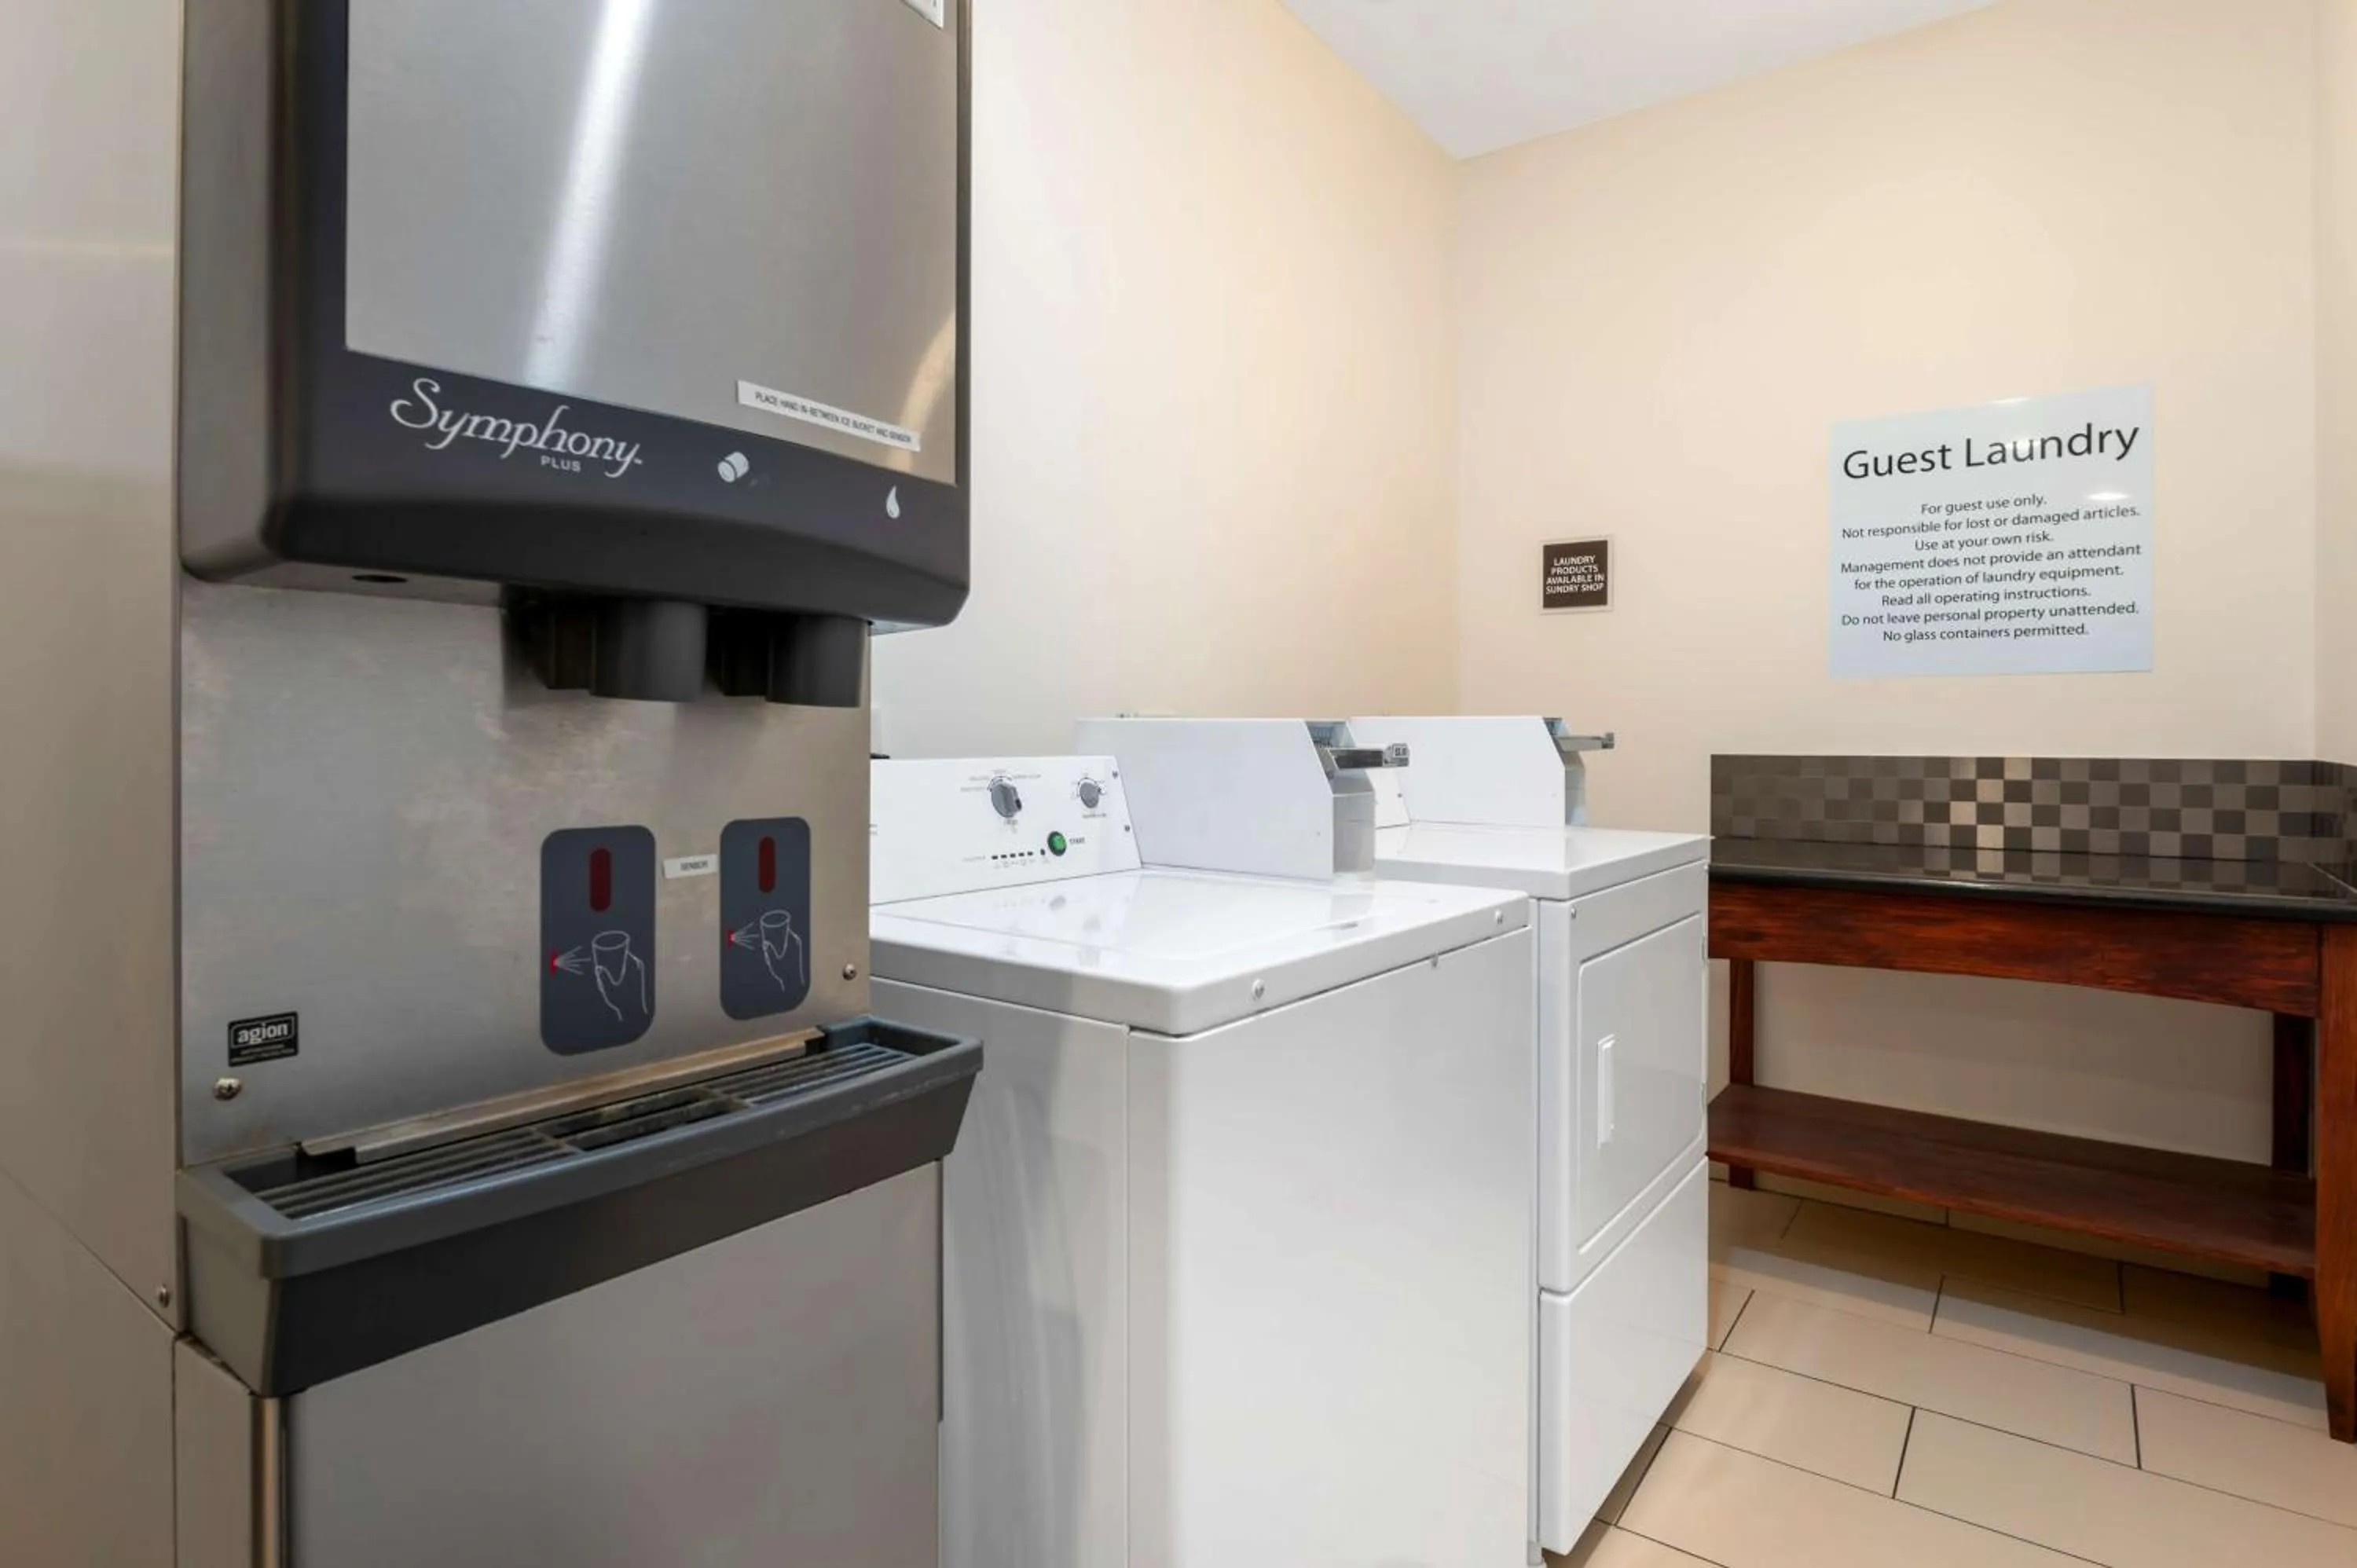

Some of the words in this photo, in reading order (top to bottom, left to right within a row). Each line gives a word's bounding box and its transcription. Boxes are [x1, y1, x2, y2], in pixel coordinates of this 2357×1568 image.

[755, 392, 777, 406] PLACE
[390, 378, 640, 478] Symphony
[1843, 443, 1952, 479] Guest
[1965, 422, 2140, 468] Laundry
[541, 455, 581, 472] PLUS
[1921, 504, 1942, 515] For
[1945, 500, 1983, 516] guest
[1985, 498, 2010, 510] use
[2014, 493, 2047, 508] only.
[1842, 528, 1865, 539] Not
[1868, 521, 1941, 538] responsible
[1945, 518, 1963, 531] for
[1966, 518, 1991, 529] lost
[1993, 517, 2009, 527] or
[2012, 508, 2080, 526] damaged
[2082, 505, 2141, 521] articles.
[1915, 539, 1939, 551] Use
[1941, 538, 1955, 549] at
[1957, 536, 1989, 551] your
[1992, 534, 2022, 546] own
[2025, 530, 2055, 544] risk.
[1551, 565, 1598, 575] PRODUCTS
[1553, 555, 1596, 566] LAUNDRY
[1841, 558, 1925, 575] Management
[1927, 556, 1960, 568] does
[1963, 555, 1985, 566] not
[1990, 550, 2044, 566] provide
[2046, 550, 2064, 561] an
[2068, 544, 2142, 559] attendant
[1546, 574, 1593, 584] AVAILABLE
[1594, 573, 1604, 582] IN
[1854, 579, 1872, 590] for
[1875, 577, 1896, 589] the
[1898, 573, 1963, 589] operation
[1965, 571, 1979, 584] of
[1982, 569, 2036, 584] laundry
[2039, 565, 2124, 581] equipment.
[1546, 584, 1579, 595] SUNDRY
[1581, 582, 1604, 592] SHOP
[1882, 594, 1914, 606] Read
[1916, 592, 1931, 605] all
[1934, 590, 2000, 605] operating
[2003, 586, 2092, 601] instructions.
[1842, 614, 1860, 626] Do
[1862, 614, 1884, 625] not
[1886, 613, 1921, 624] leave
[1924, 608, 1981, 625] personal
[1984, 608, 2045, 621] property
[2049, 601, 2139, 617] unattended.
[1882, 630, 1902, 642] No
[1904, 629, 1937, 643] glass
[1940, 628, 2011, 640] containers
[2014, 623, 2090, 639] permitted.
[238, 1023, 288, 1045] agion
